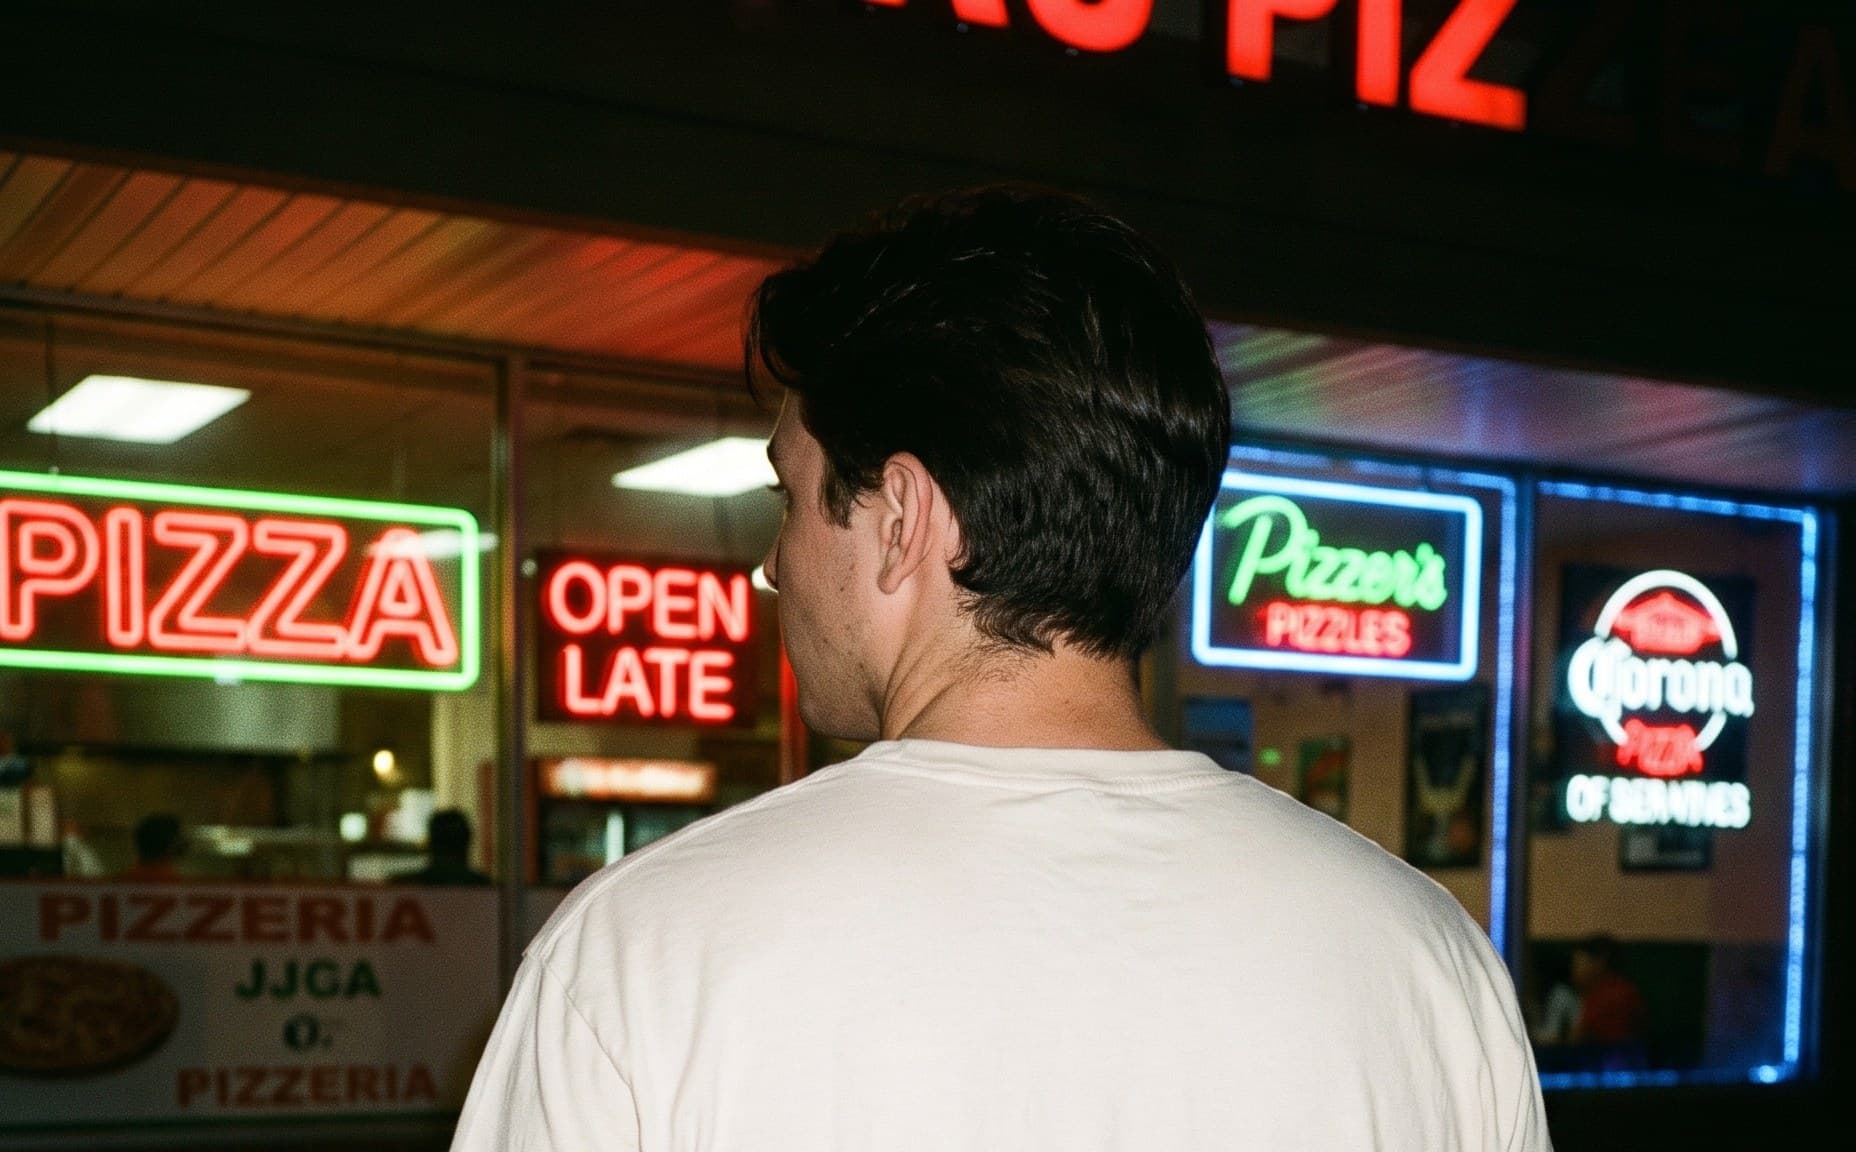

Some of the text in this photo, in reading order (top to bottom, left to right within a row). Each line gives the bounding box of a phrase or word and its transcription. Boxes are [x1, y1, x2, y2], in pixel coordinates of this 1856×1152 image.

[0, 499, 460, 667] PIZZA
[549, 560, 749, 643] OPEN
[563, 644, 735, 721] LATE
[38, 892, 437, 946] PIZZERIA
[176, 1061, 440, 1108] PIZZERIA
